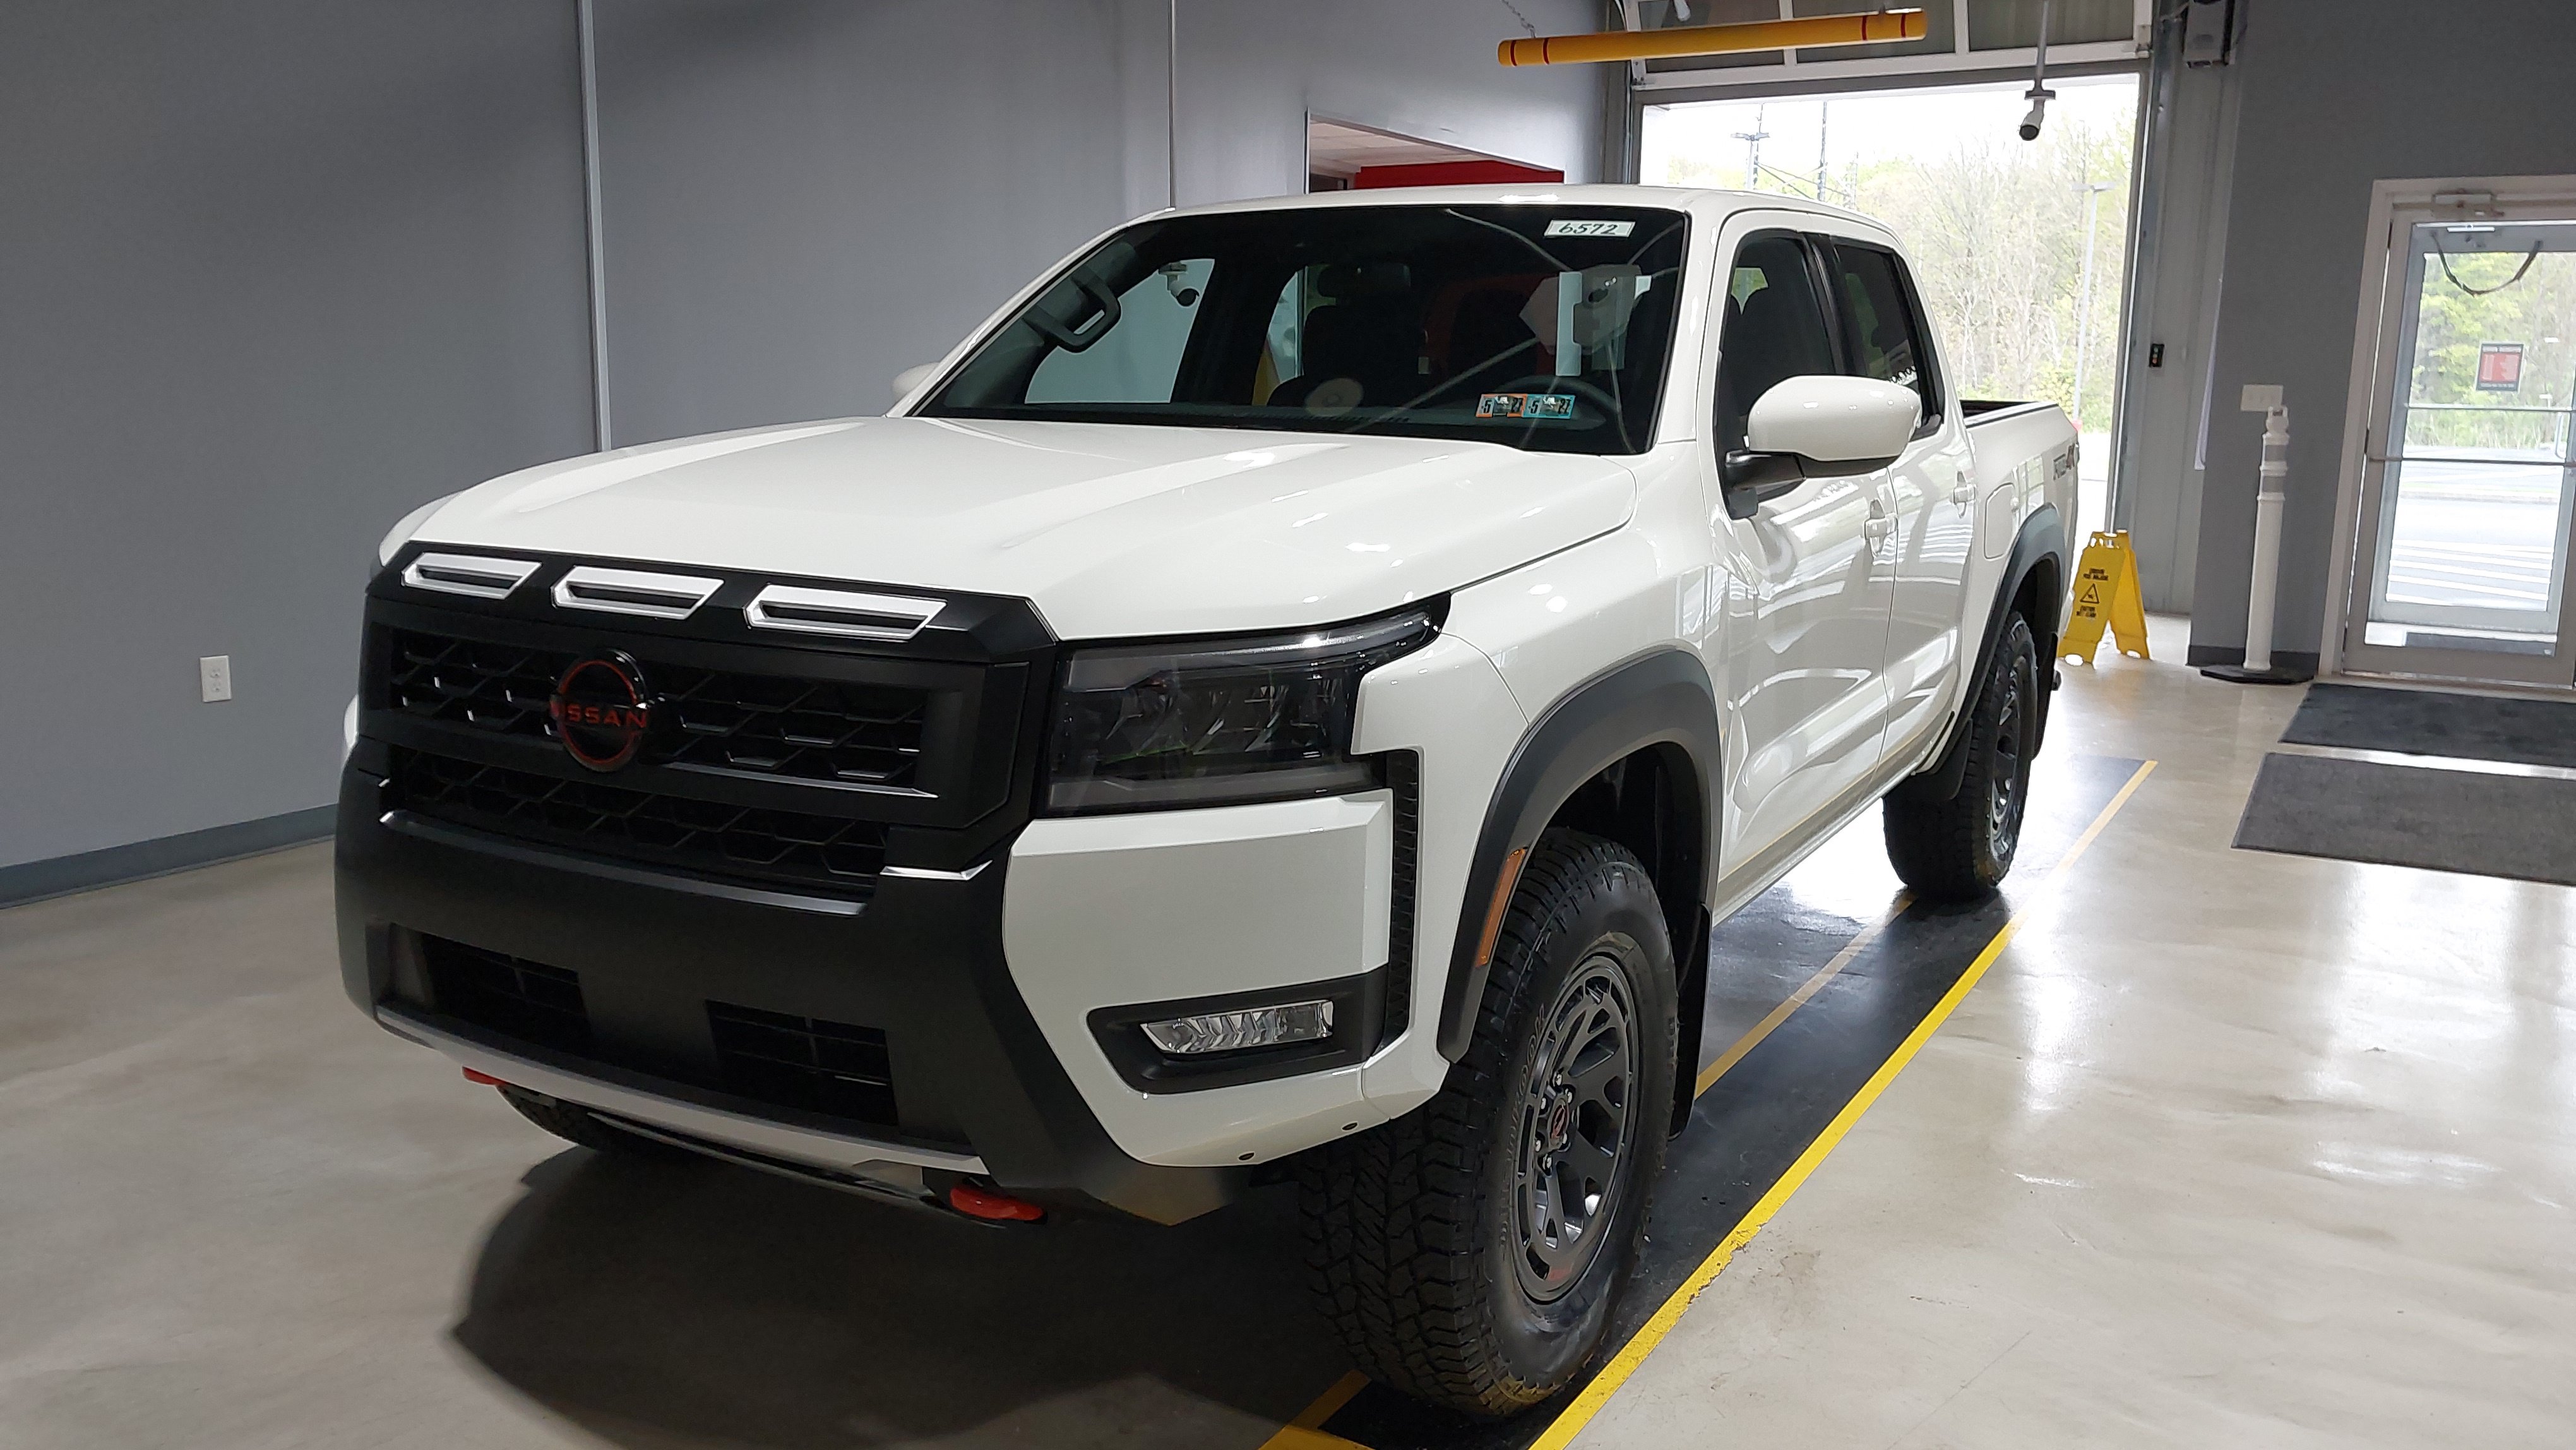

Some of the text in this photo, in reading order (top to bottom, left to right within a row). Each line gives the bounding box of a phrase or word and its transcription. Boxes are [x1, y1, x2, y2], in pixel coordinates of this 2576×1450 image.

[1559, 223, 1618, 235] 6572
[1483, 400, 1493, 413] 5
[1530, 400, 1541, 414] 5
[551, 700, 647, 728] SSAN
